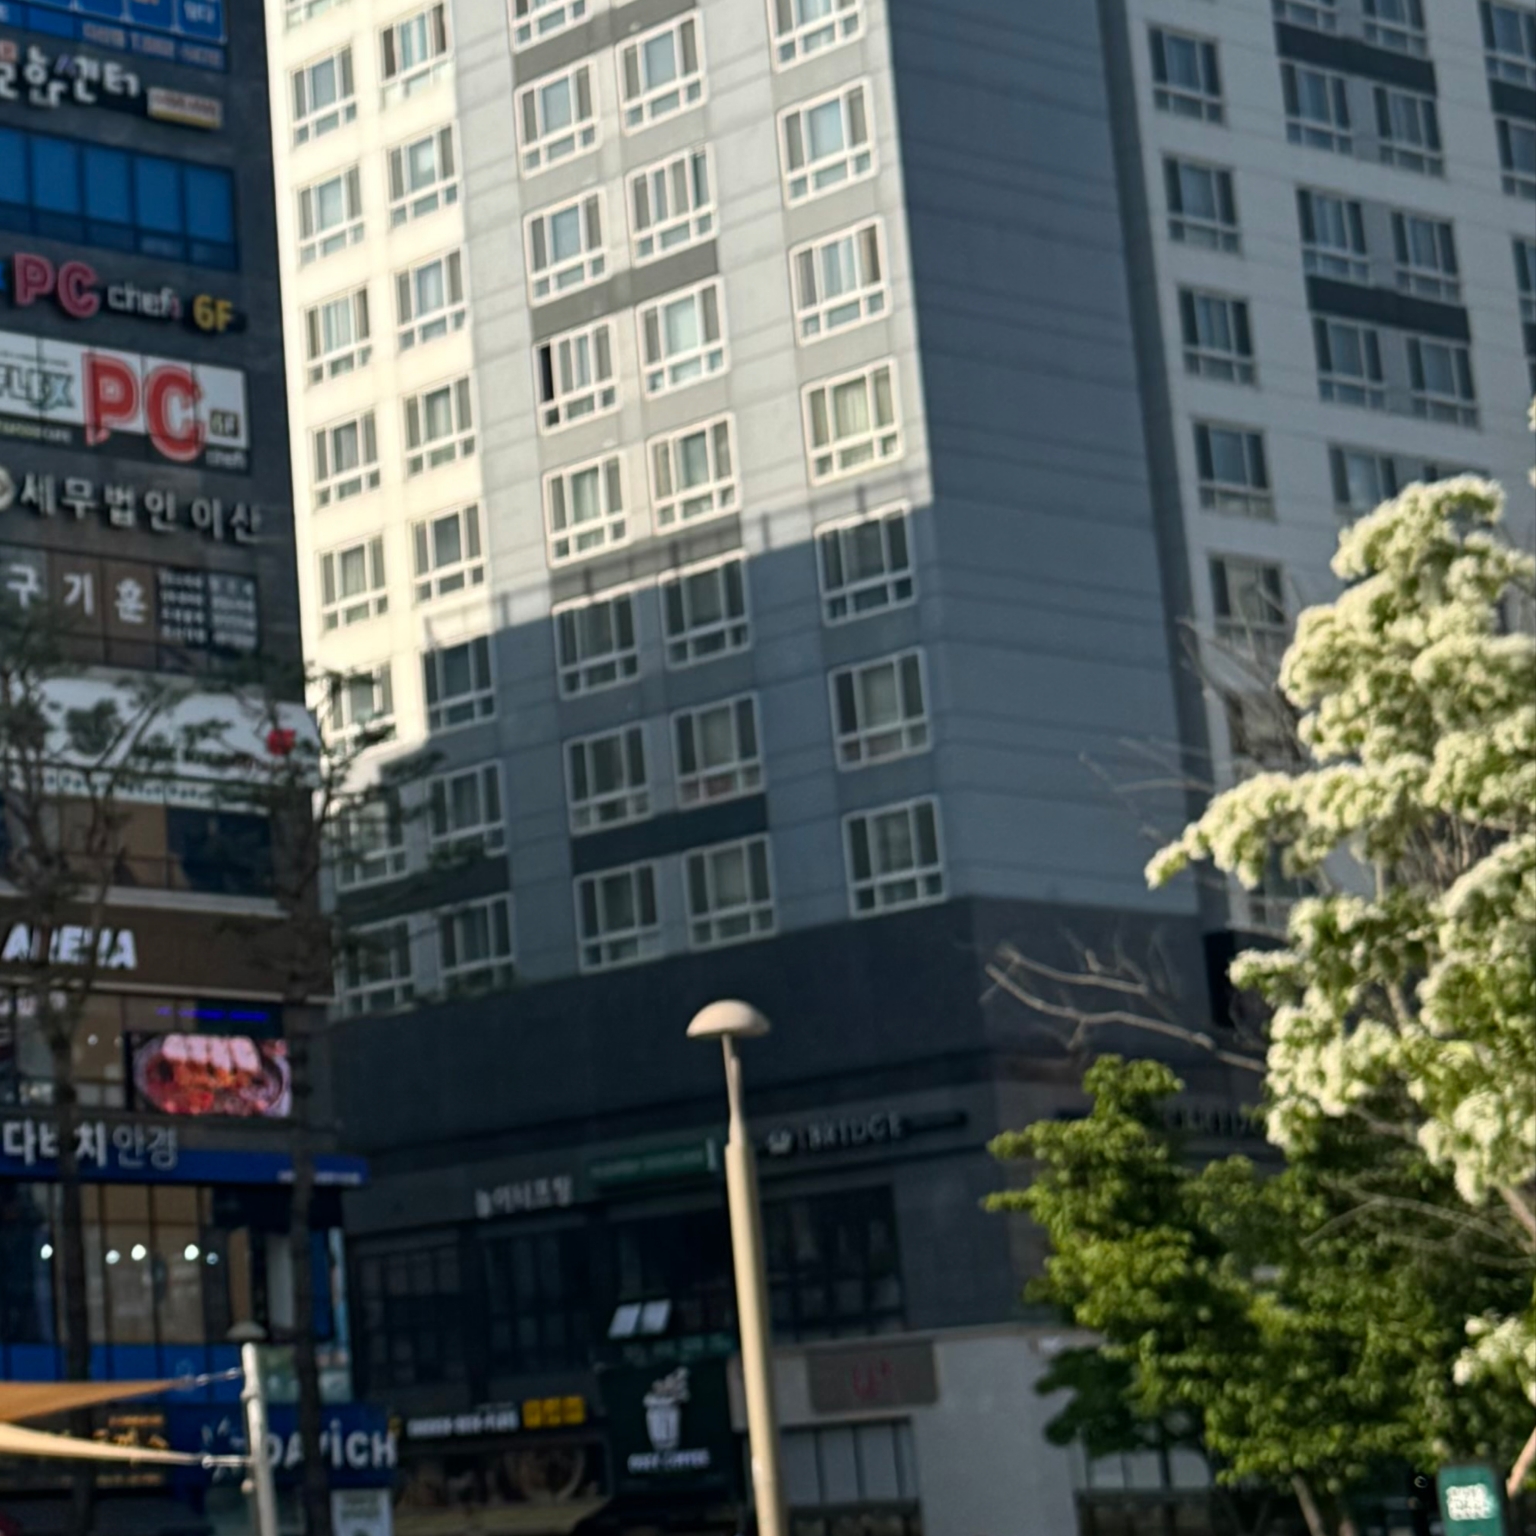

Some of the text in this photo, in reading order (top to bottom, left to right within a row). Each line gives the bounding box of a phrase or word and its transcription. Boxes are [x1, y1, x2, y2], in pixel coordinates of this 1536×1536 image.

[12, 251, 100, 318] PC
[192, 295, 234, 332] 6F
[81, 351, 207, 463] PC
[20, 474, 263, 544] 세무법인 이산
